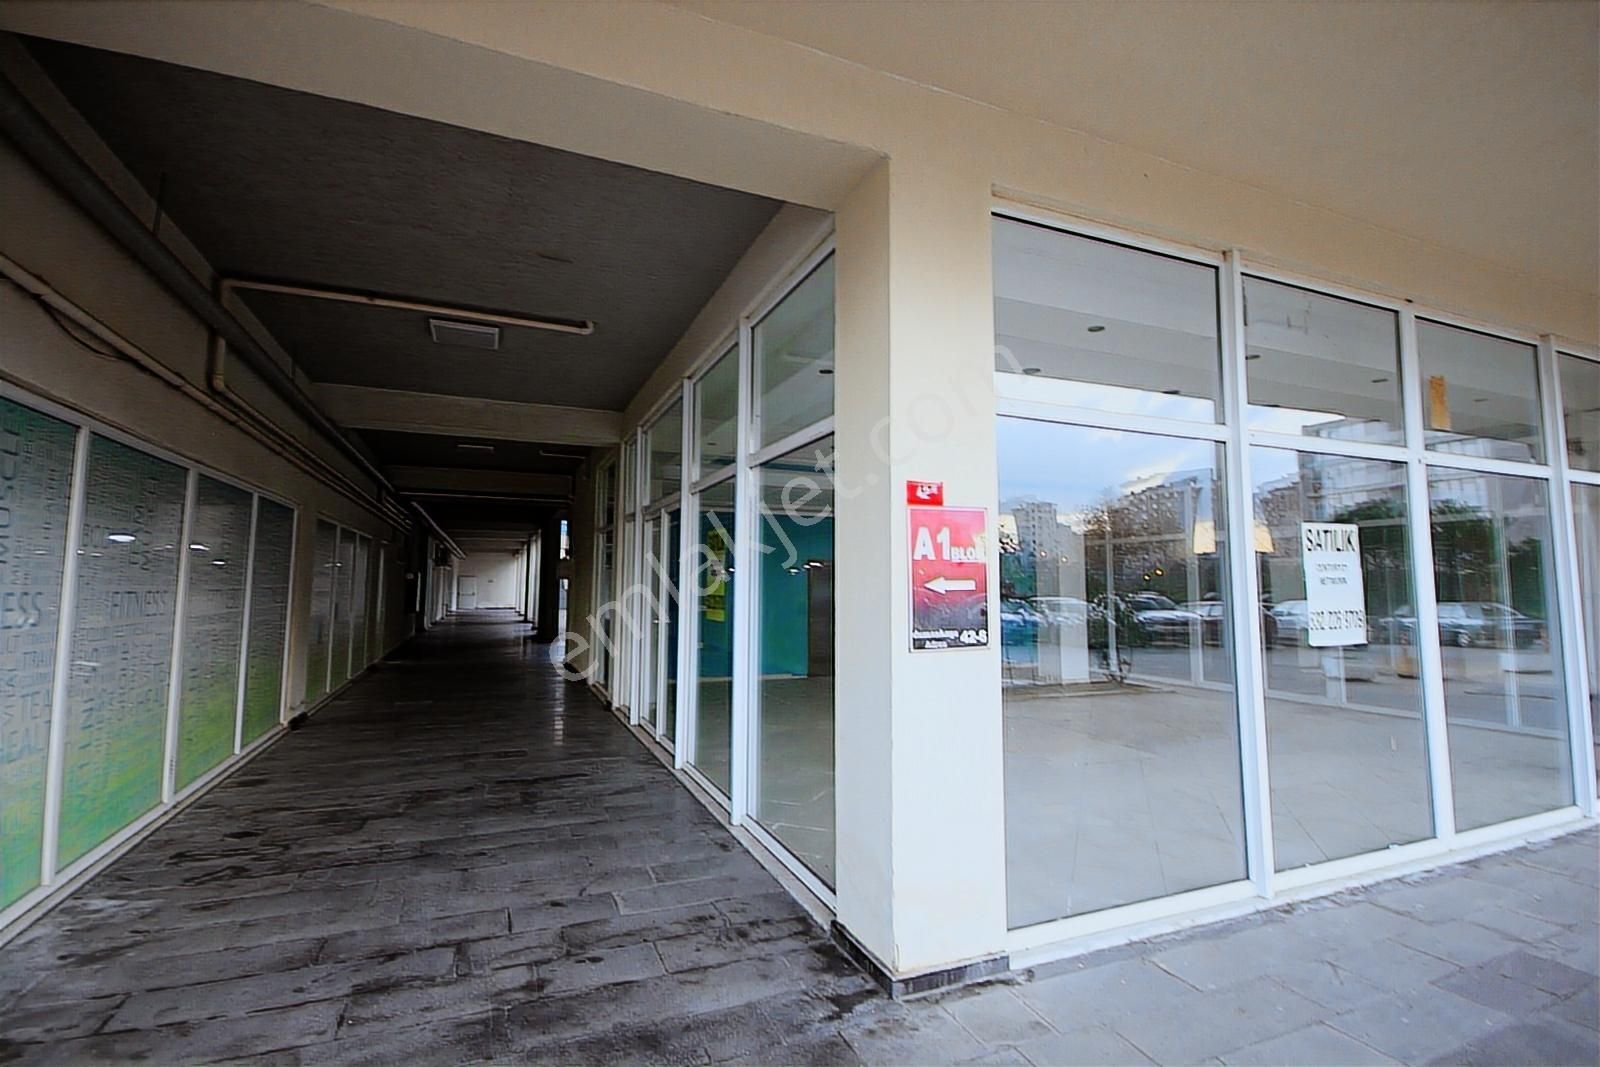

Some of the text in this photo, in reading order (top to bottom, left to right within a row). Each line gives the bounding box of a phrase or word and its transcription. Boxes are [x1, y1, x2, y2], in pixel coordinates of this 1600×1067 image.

[913, 526, 984, 561] A1 BLO
[1306, 528, 1357, 552] SATILIK
